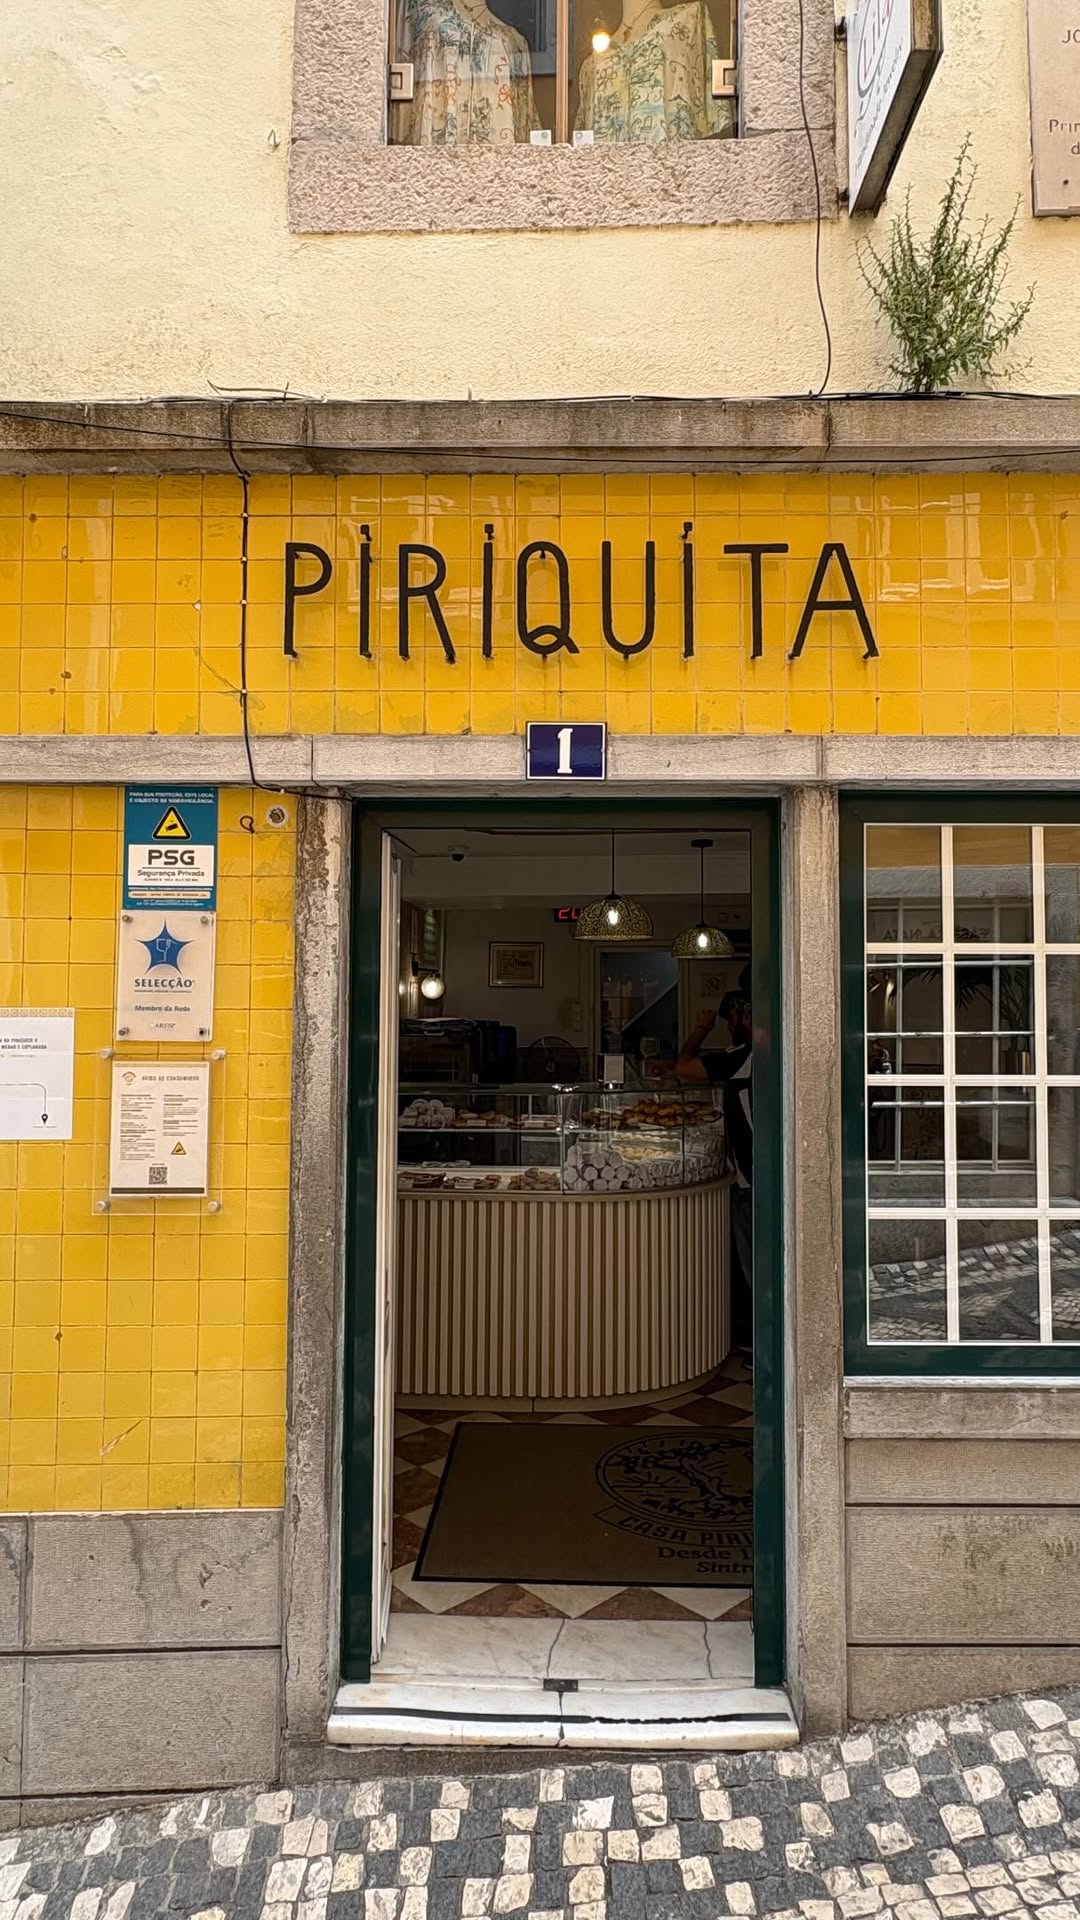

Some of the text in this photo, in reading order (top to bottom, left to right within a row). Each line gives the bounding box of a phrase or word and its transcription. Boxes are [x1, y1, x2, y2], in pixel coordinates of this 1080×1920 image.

[557, 728, 574, 774] 1
[148, 849, 195, 865] PSG
[137, 869, 175, 877] Segurança
[134, 977, 192, 989] SELECÇÃO
[618, 1516, 688, 1541] CASA
[657, 1546, 732, 1560] Desde
